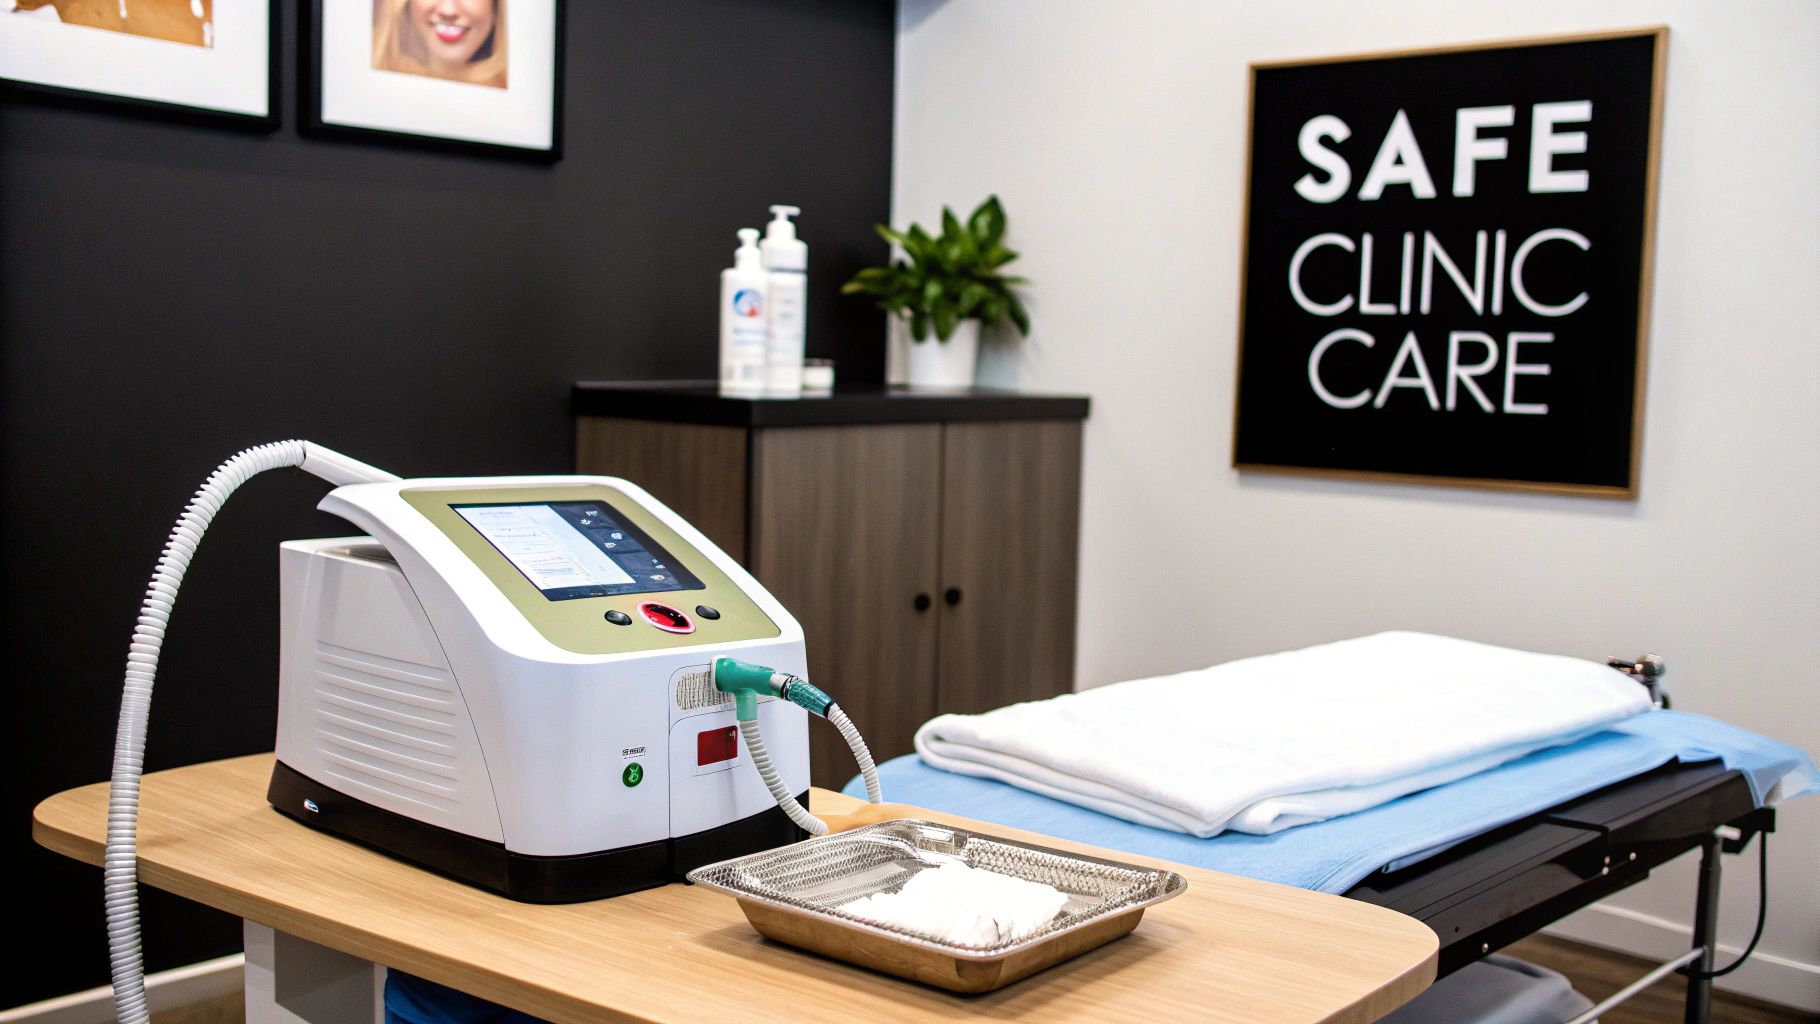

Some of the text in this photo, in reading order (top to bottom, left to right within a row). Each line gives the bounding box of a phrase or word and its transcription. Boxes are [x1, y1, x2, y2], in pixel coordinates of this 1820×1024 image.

[1294, 100, 1593, 203] SAFE
[1289, 228, 1591, 317] CLINIC
[1308, 328, 1555, 415] CARE
